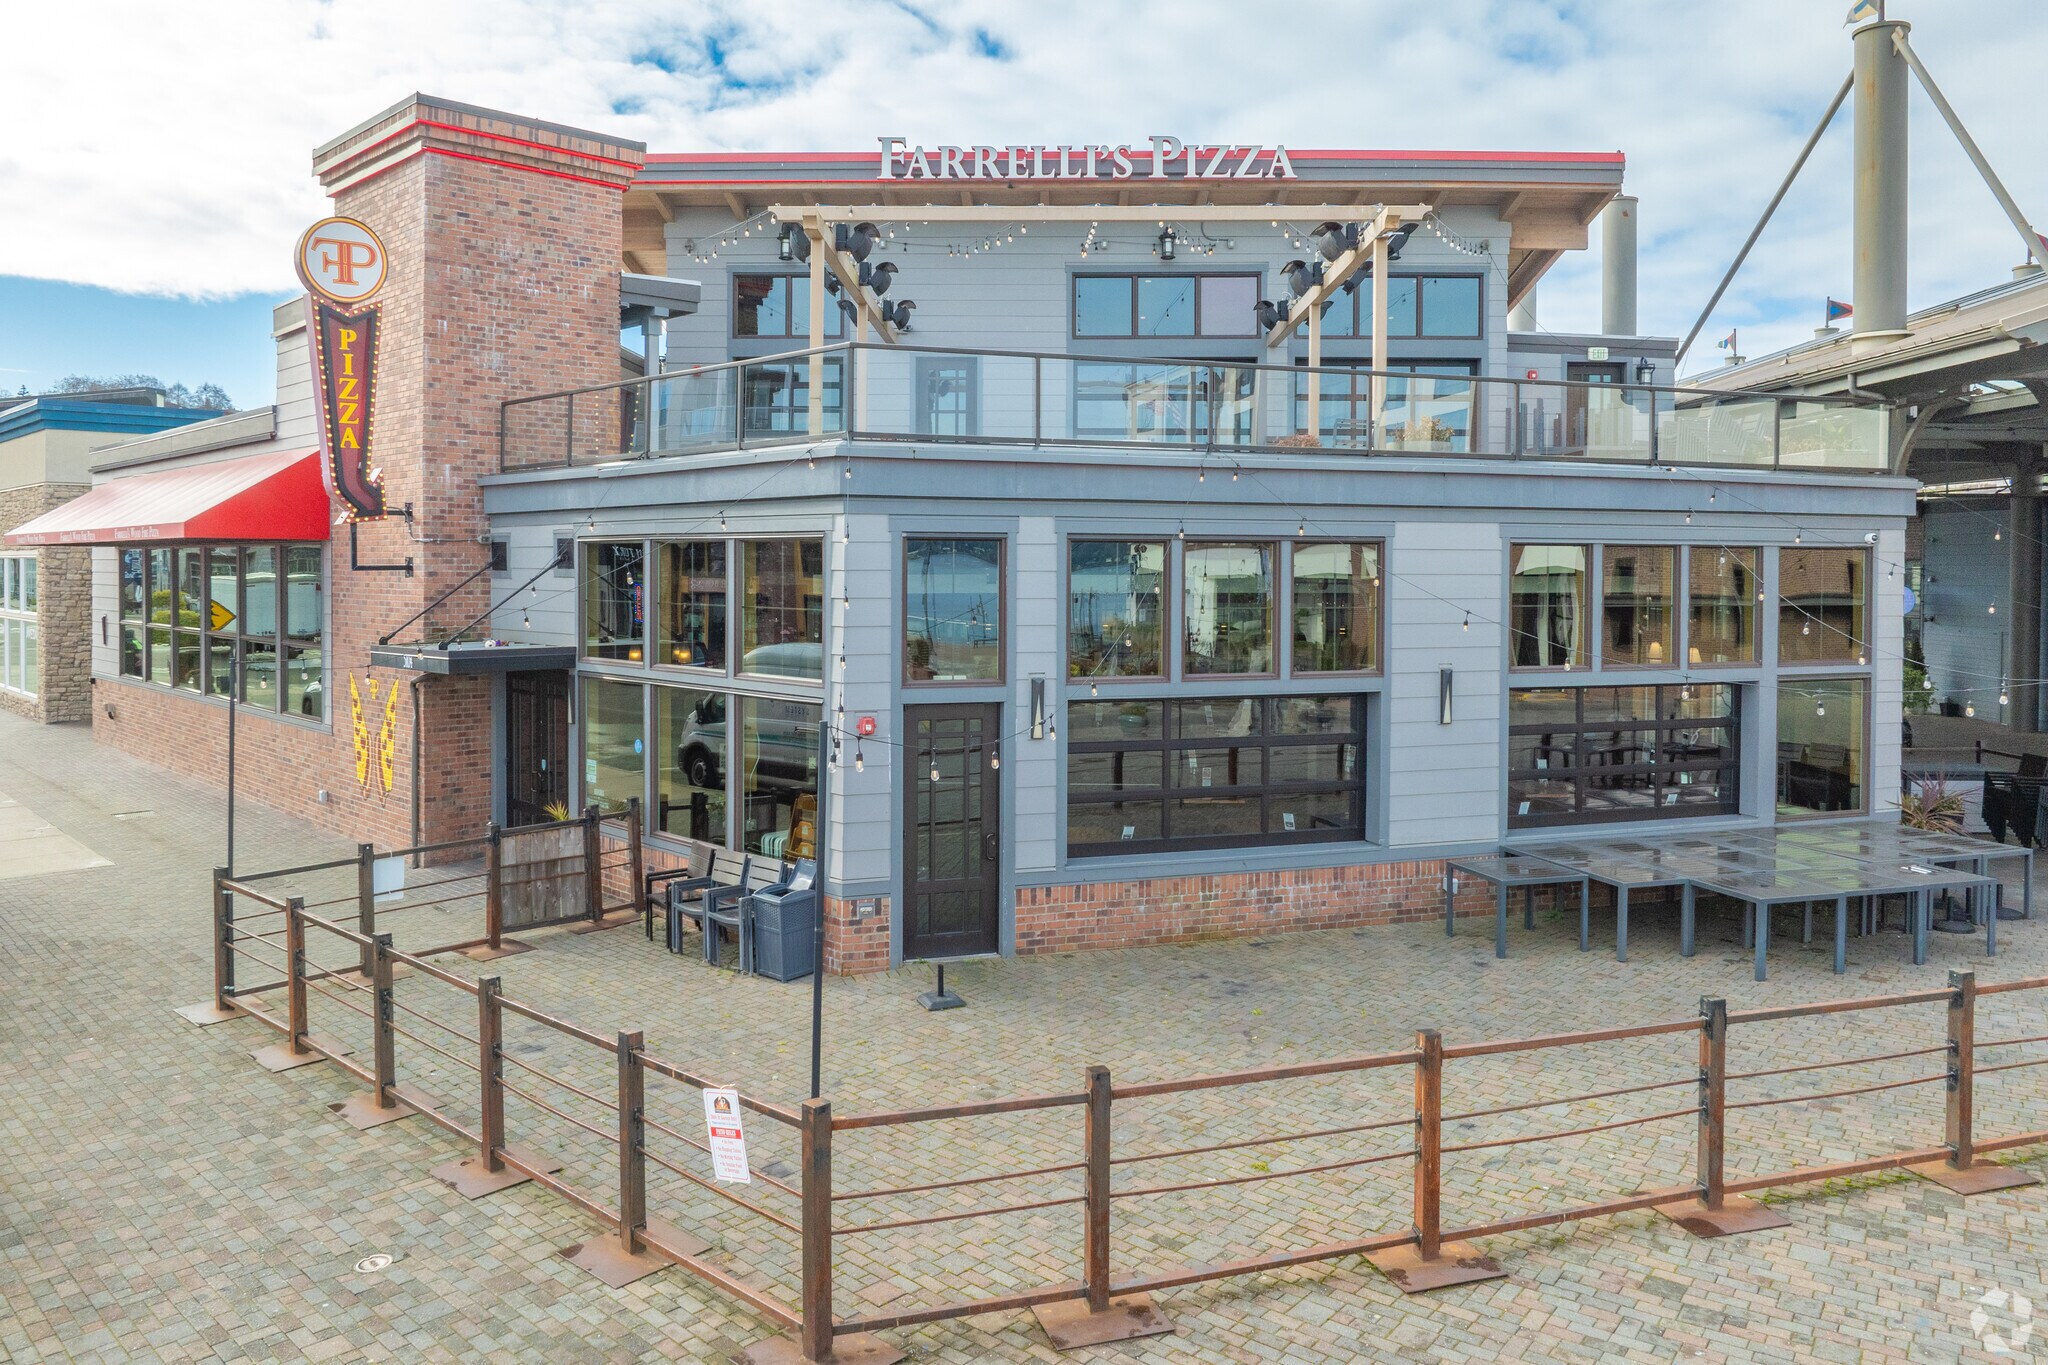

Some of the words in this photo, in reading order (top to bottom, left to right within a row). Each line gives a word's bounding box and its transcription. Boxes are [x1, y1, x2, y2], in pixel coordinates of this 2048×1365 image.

[877, 136, 1133, 180] FARRELLI'S
[1148, 134, 1298, 180] PIZZA
[1592, 348, 1606, 359] EXIT
[338, 328, 360, 450] PIZZA
